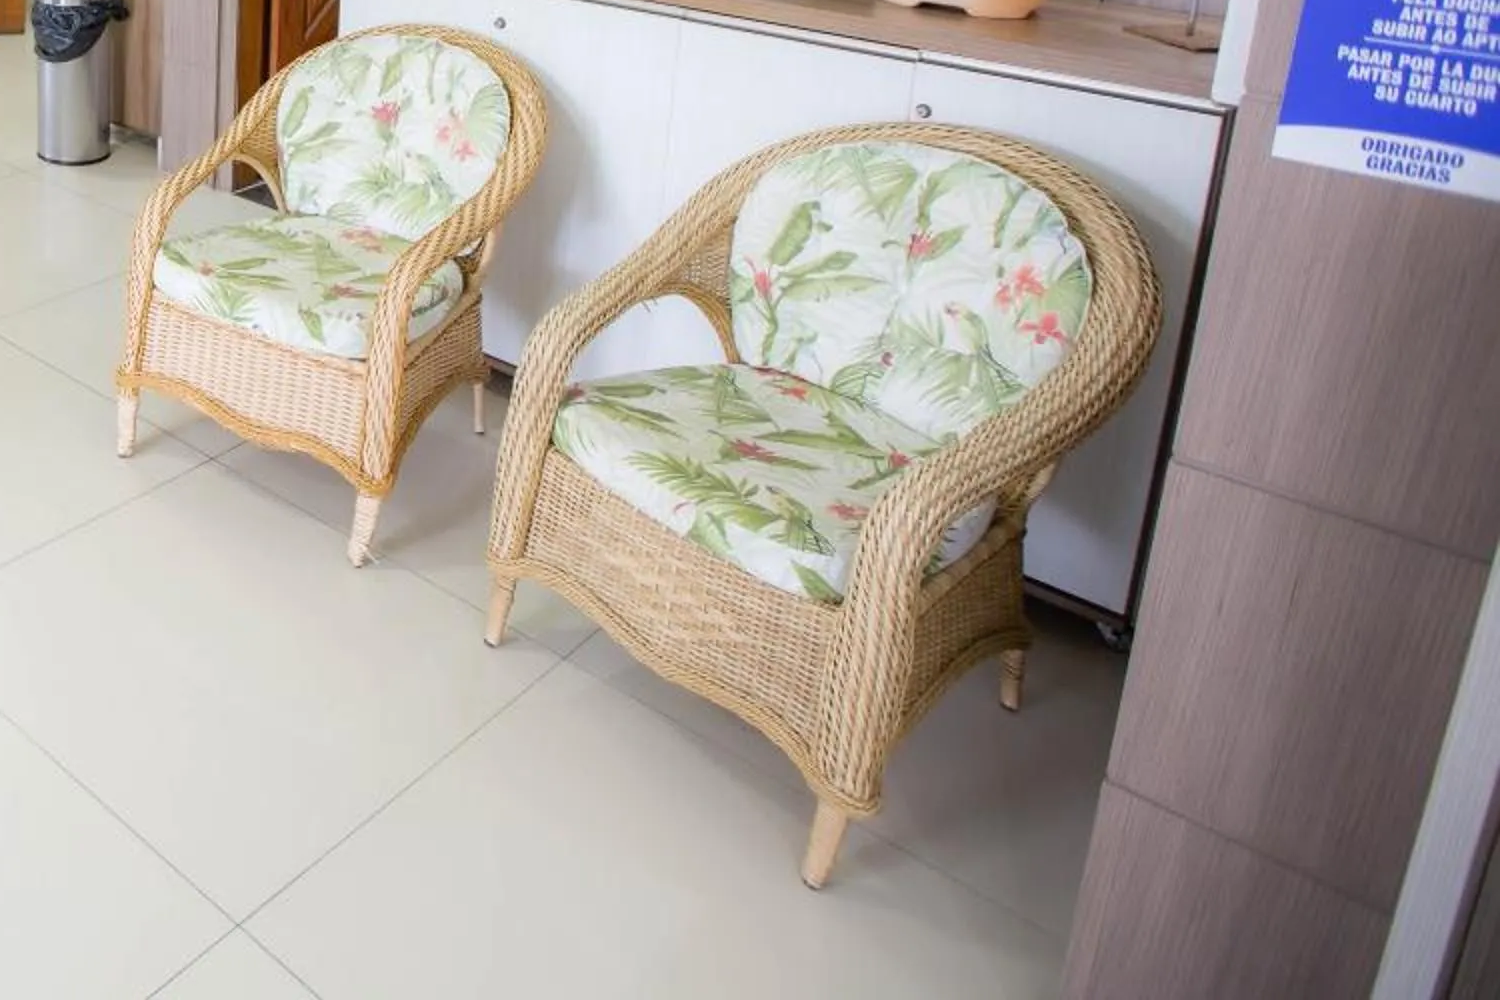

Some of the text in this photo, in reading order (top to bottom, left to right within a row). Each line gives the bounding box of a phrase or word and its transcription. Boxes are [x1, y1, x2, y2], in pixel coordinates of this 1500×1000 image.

[1371, 18, 1427, 41] SUBIR
[1432, 27, 1458, 45] AO
[1400, 5, 1490, 32] ANTES DE
[1337, 44, 1393, 68] PASAR
[1398, 53, 1436, 74] POR
[1441, 58, 1464, 79] LA
[1347, 63, 1497, 103] ANTES DE SUBIR
[1373, 84, 1478, 118] SU CUARTO
[1360, 135, 1465, 169] OBRIGADO
[1366, 153, 1452, 184] GRACIAS
